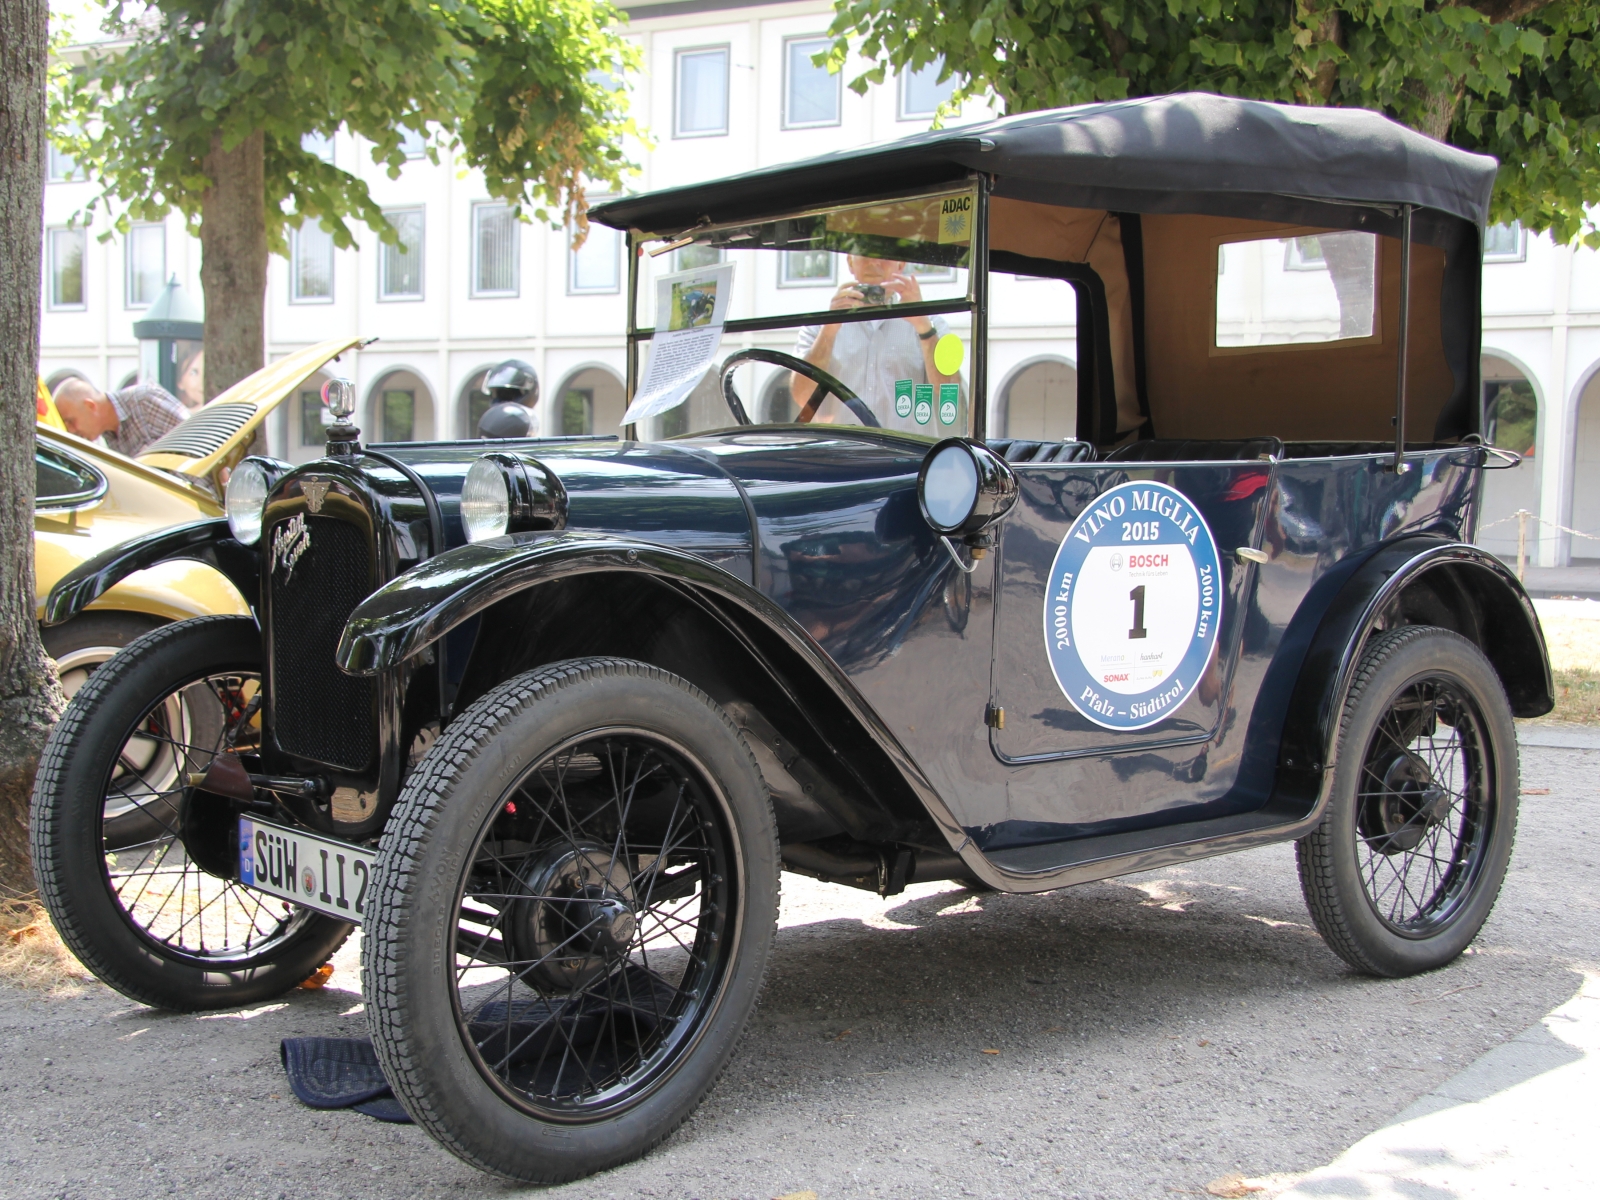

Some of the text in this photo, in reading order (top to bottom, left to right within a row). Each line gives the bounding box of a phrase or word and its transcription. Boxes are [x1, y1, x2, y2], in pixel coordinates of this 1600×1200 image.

[942, 196, 971, 214] ADAC
[1074, 490, 1199, 546] VINO MIGLIA
[1121, 521, 1160, 541] 2015
[1129, 554, 1169, 568] BOSCH
[1054, 572, 1073, 650] 2000 km
[1128, 585, 1147, 639] 1
[1197, 564, 1213, 638] 2000 km
[1103, 673, 1129, 683] SONAX
[1080, 685, 1115, 717] Pfalz
[1130, 679, 1184, 719] Südtirol
[245, 858, 251, 873] D
